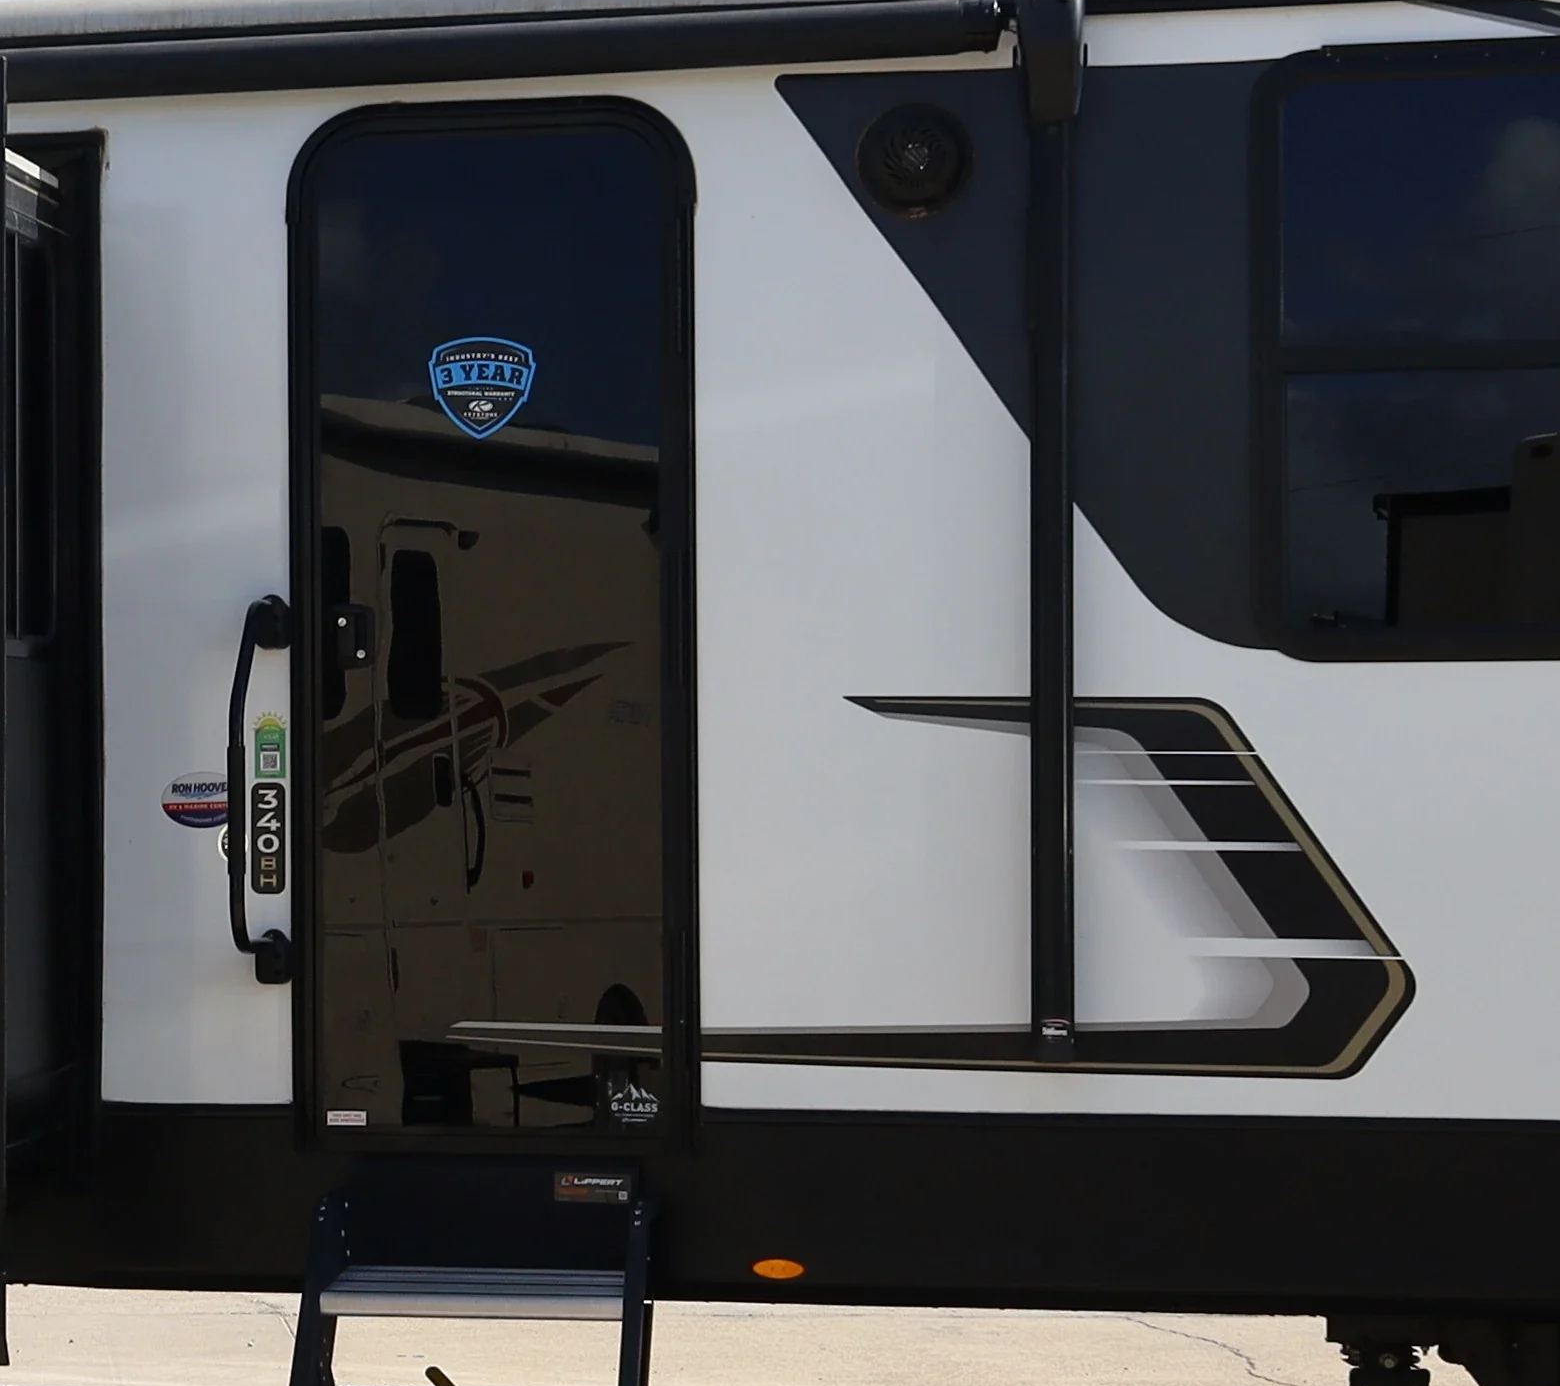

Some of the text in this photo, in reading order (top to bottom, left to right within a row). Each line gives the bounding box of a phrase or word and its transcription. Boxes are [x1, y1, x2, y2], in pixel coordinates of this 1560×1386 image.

[440, 362, 525, 386] 3 YEAR
[171, 781, 228, 794] RON HOOVE
